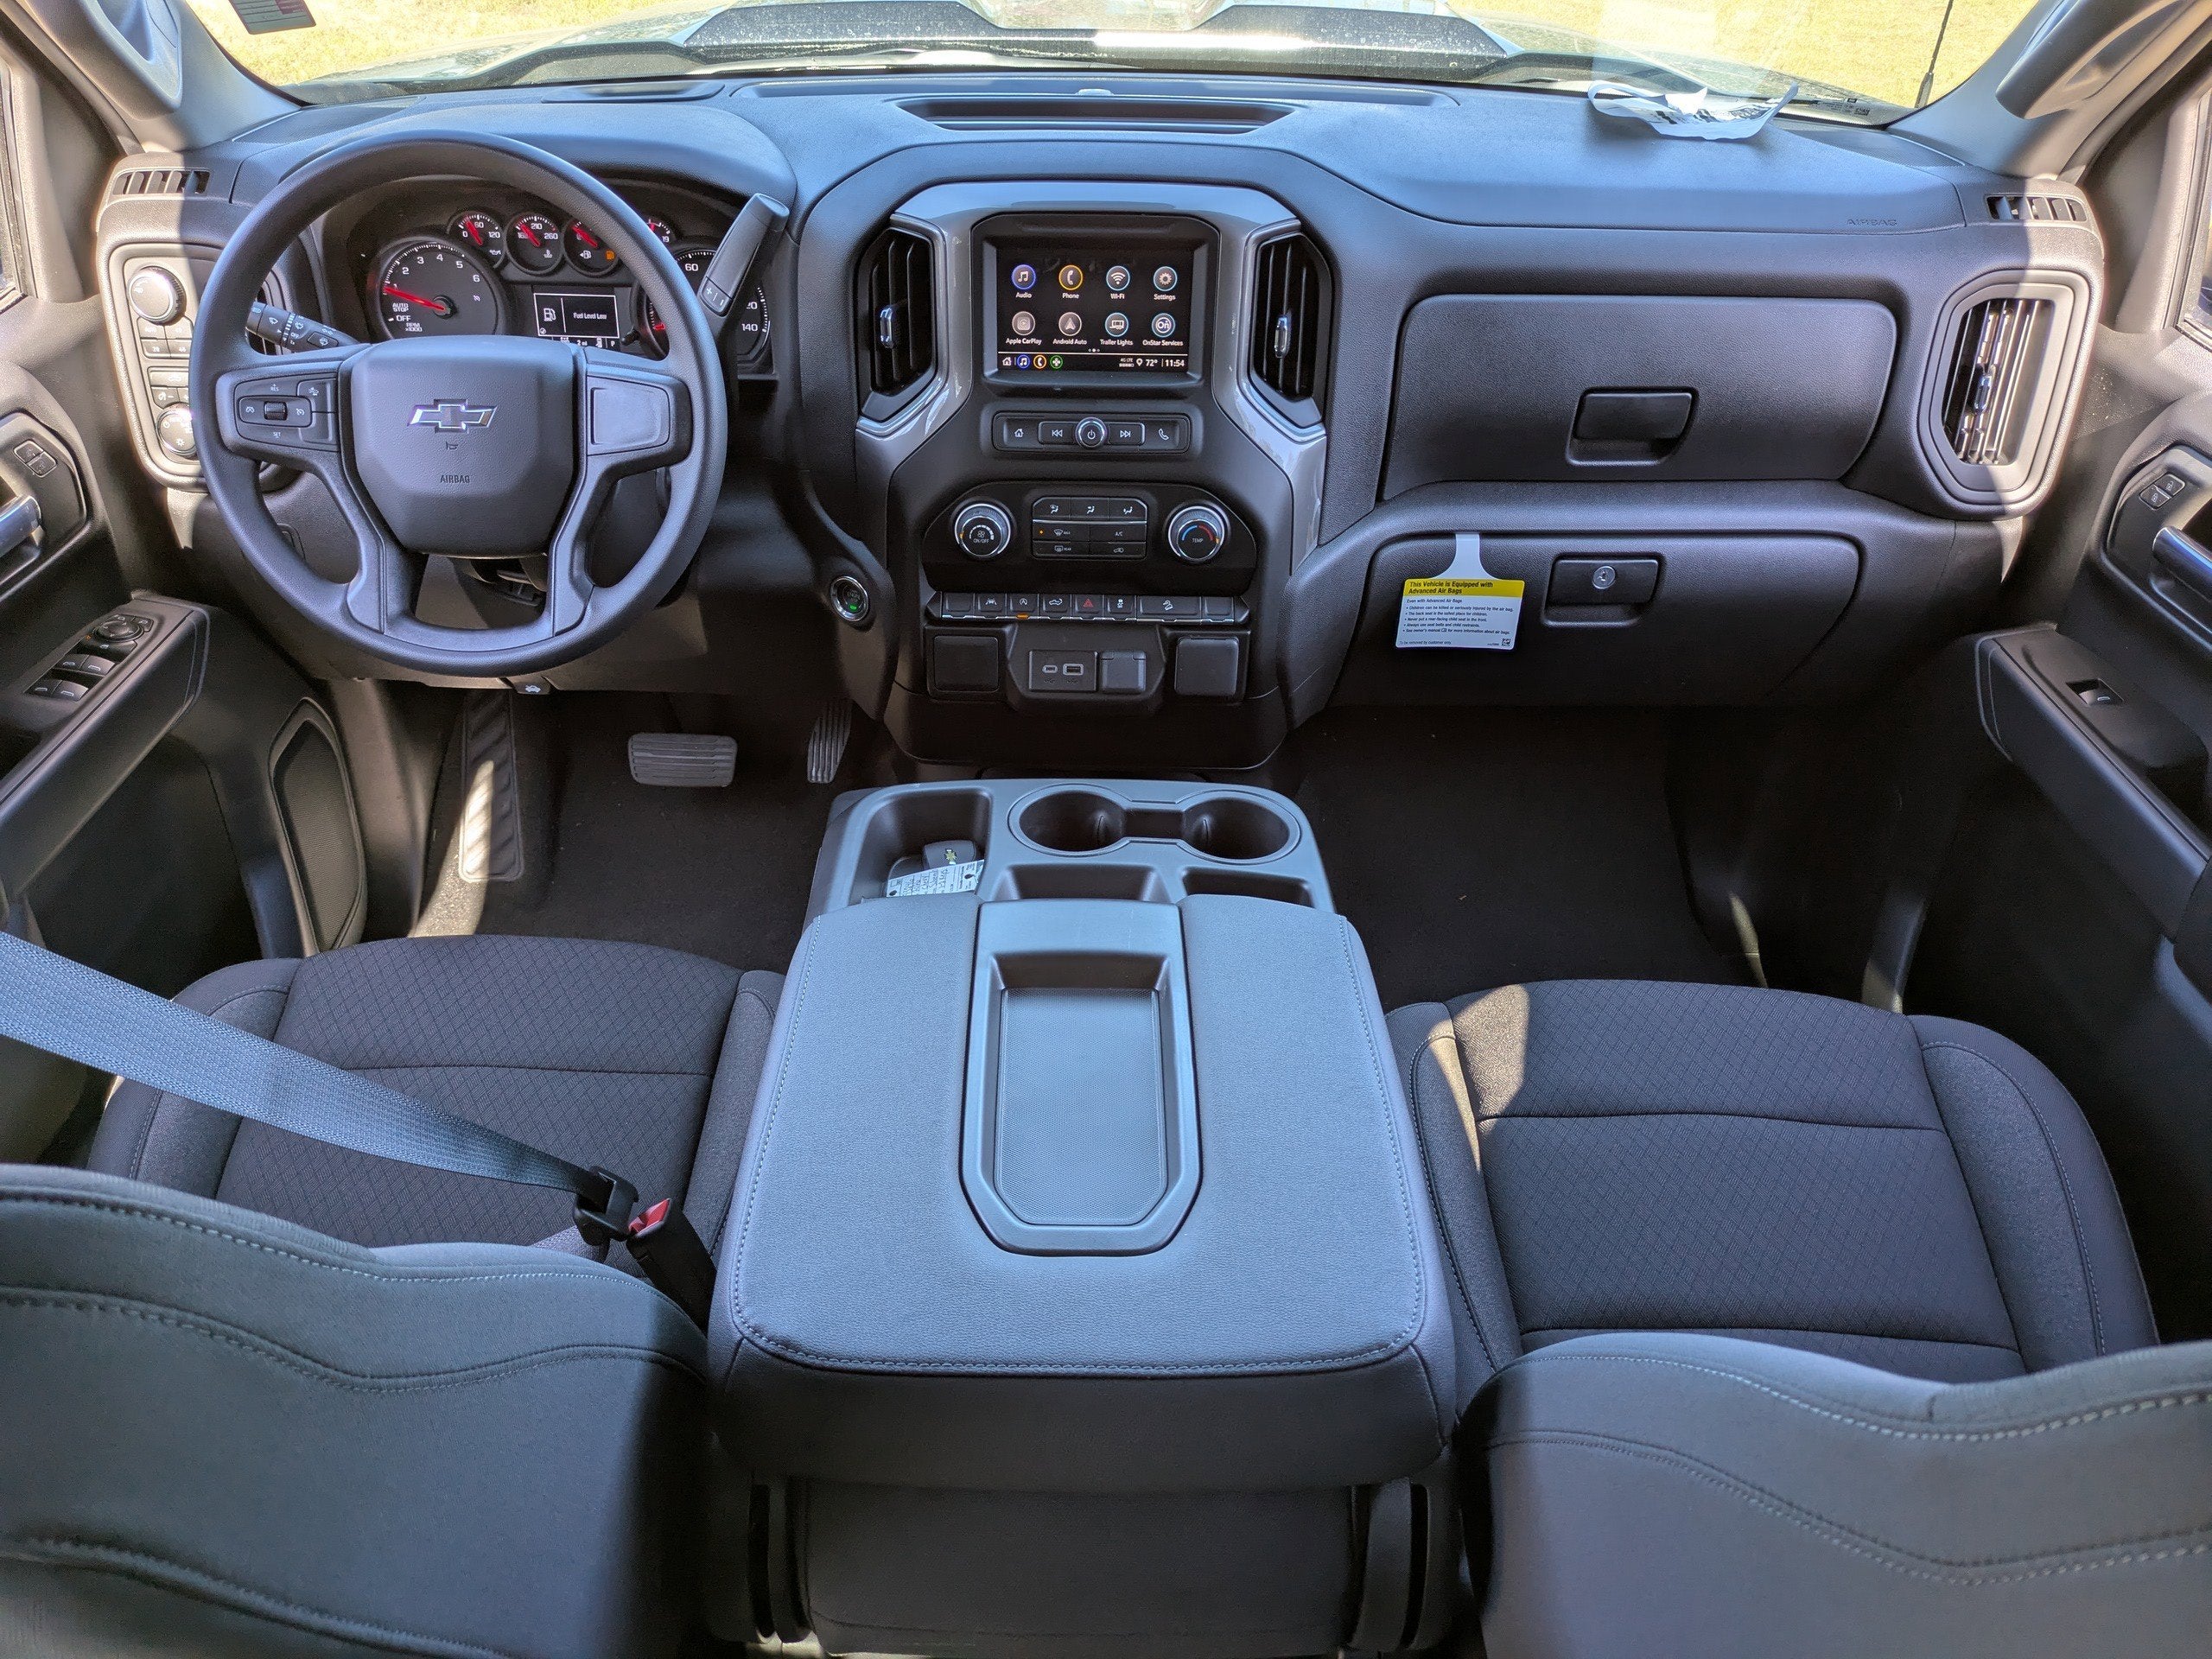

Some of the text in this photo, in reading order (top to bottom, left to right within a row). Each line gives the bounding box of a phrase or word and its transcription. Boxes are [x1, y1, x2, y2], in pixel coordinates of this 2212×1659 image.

[436, 253, 444, 262] 4
[455, 260, 463, 269] 5
[741, 323, 759, 332] 140
[440, 474, 470, 484] AIRBAG
